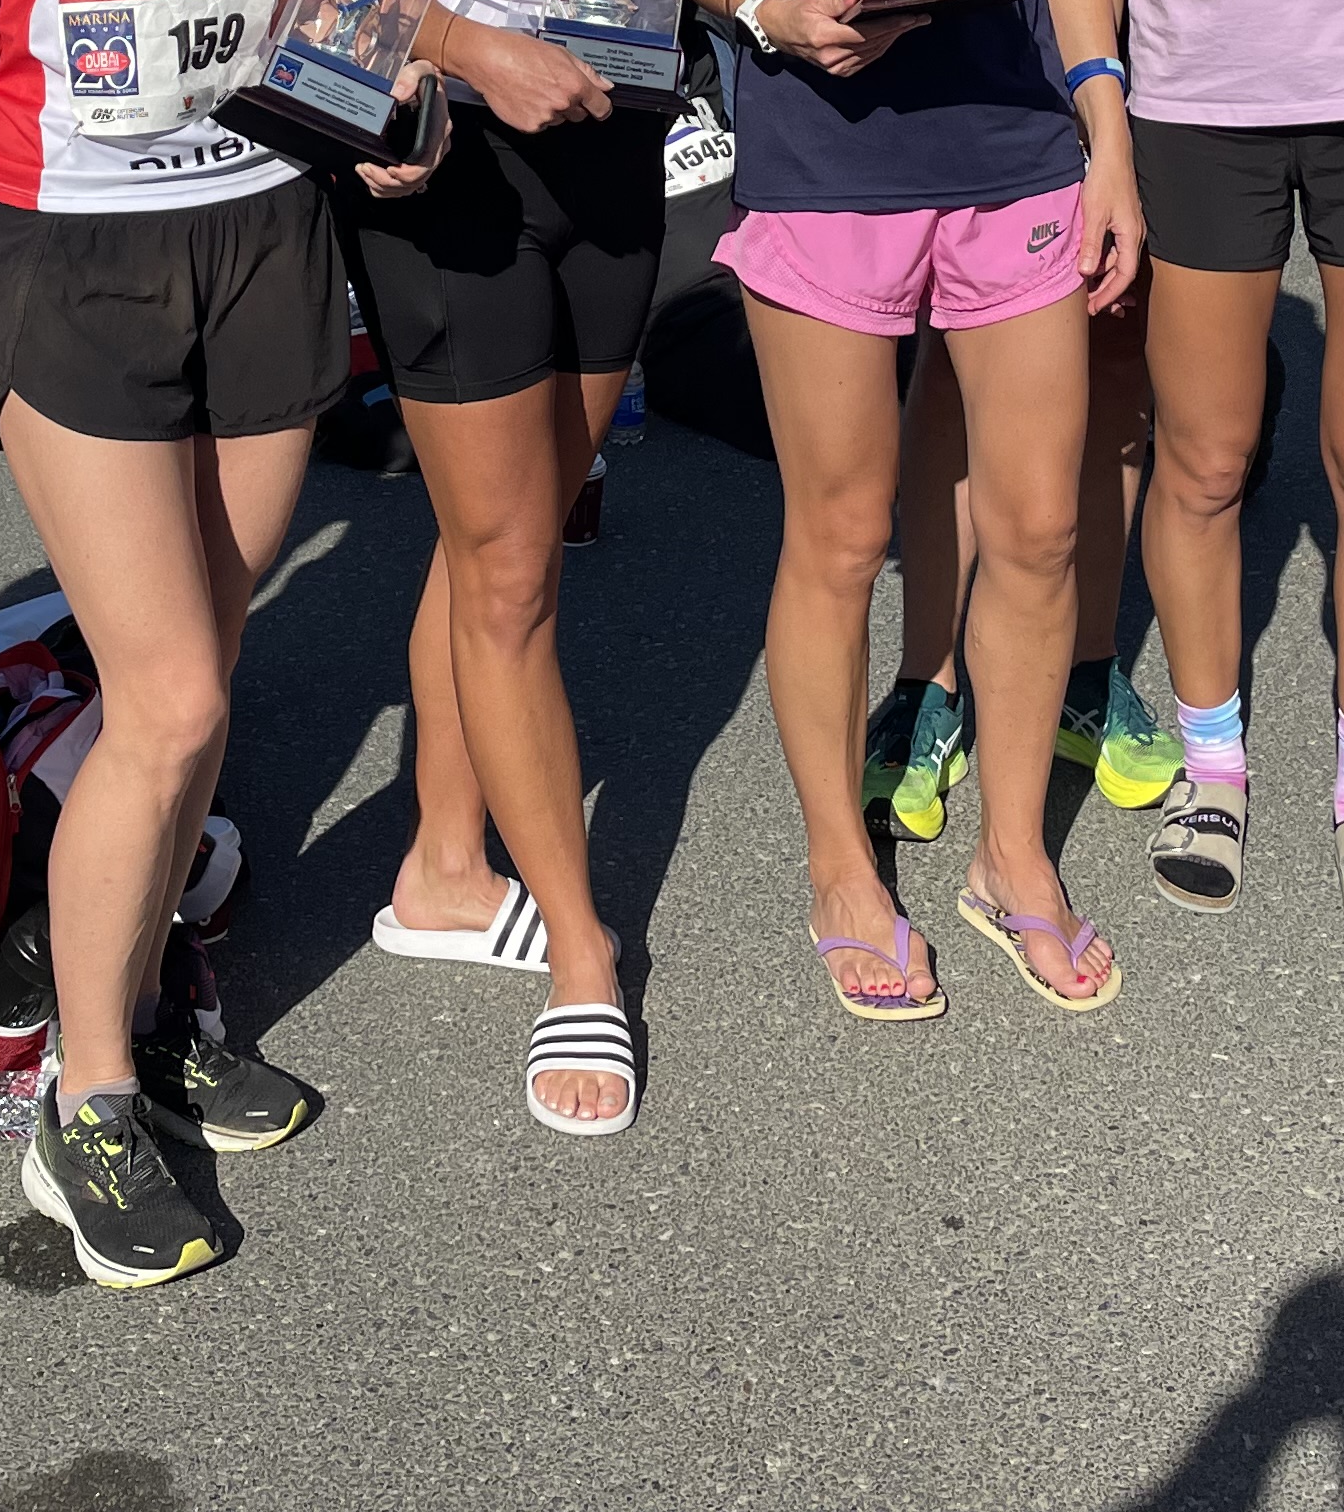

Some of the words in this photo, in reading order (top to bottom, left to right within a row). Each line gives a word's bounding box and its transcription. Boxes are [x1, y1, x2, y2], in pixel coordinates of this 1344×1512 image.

[68, 11, 132, 27] MARINA
[167, 12, 246, 75] 159
[85, 52, 120, 69] DUBAI
[668, 133, 733, 171] 1545
[1031, 219, 1060, 242] NIKE
[1179, 812, 1239, 836] VERSUS
